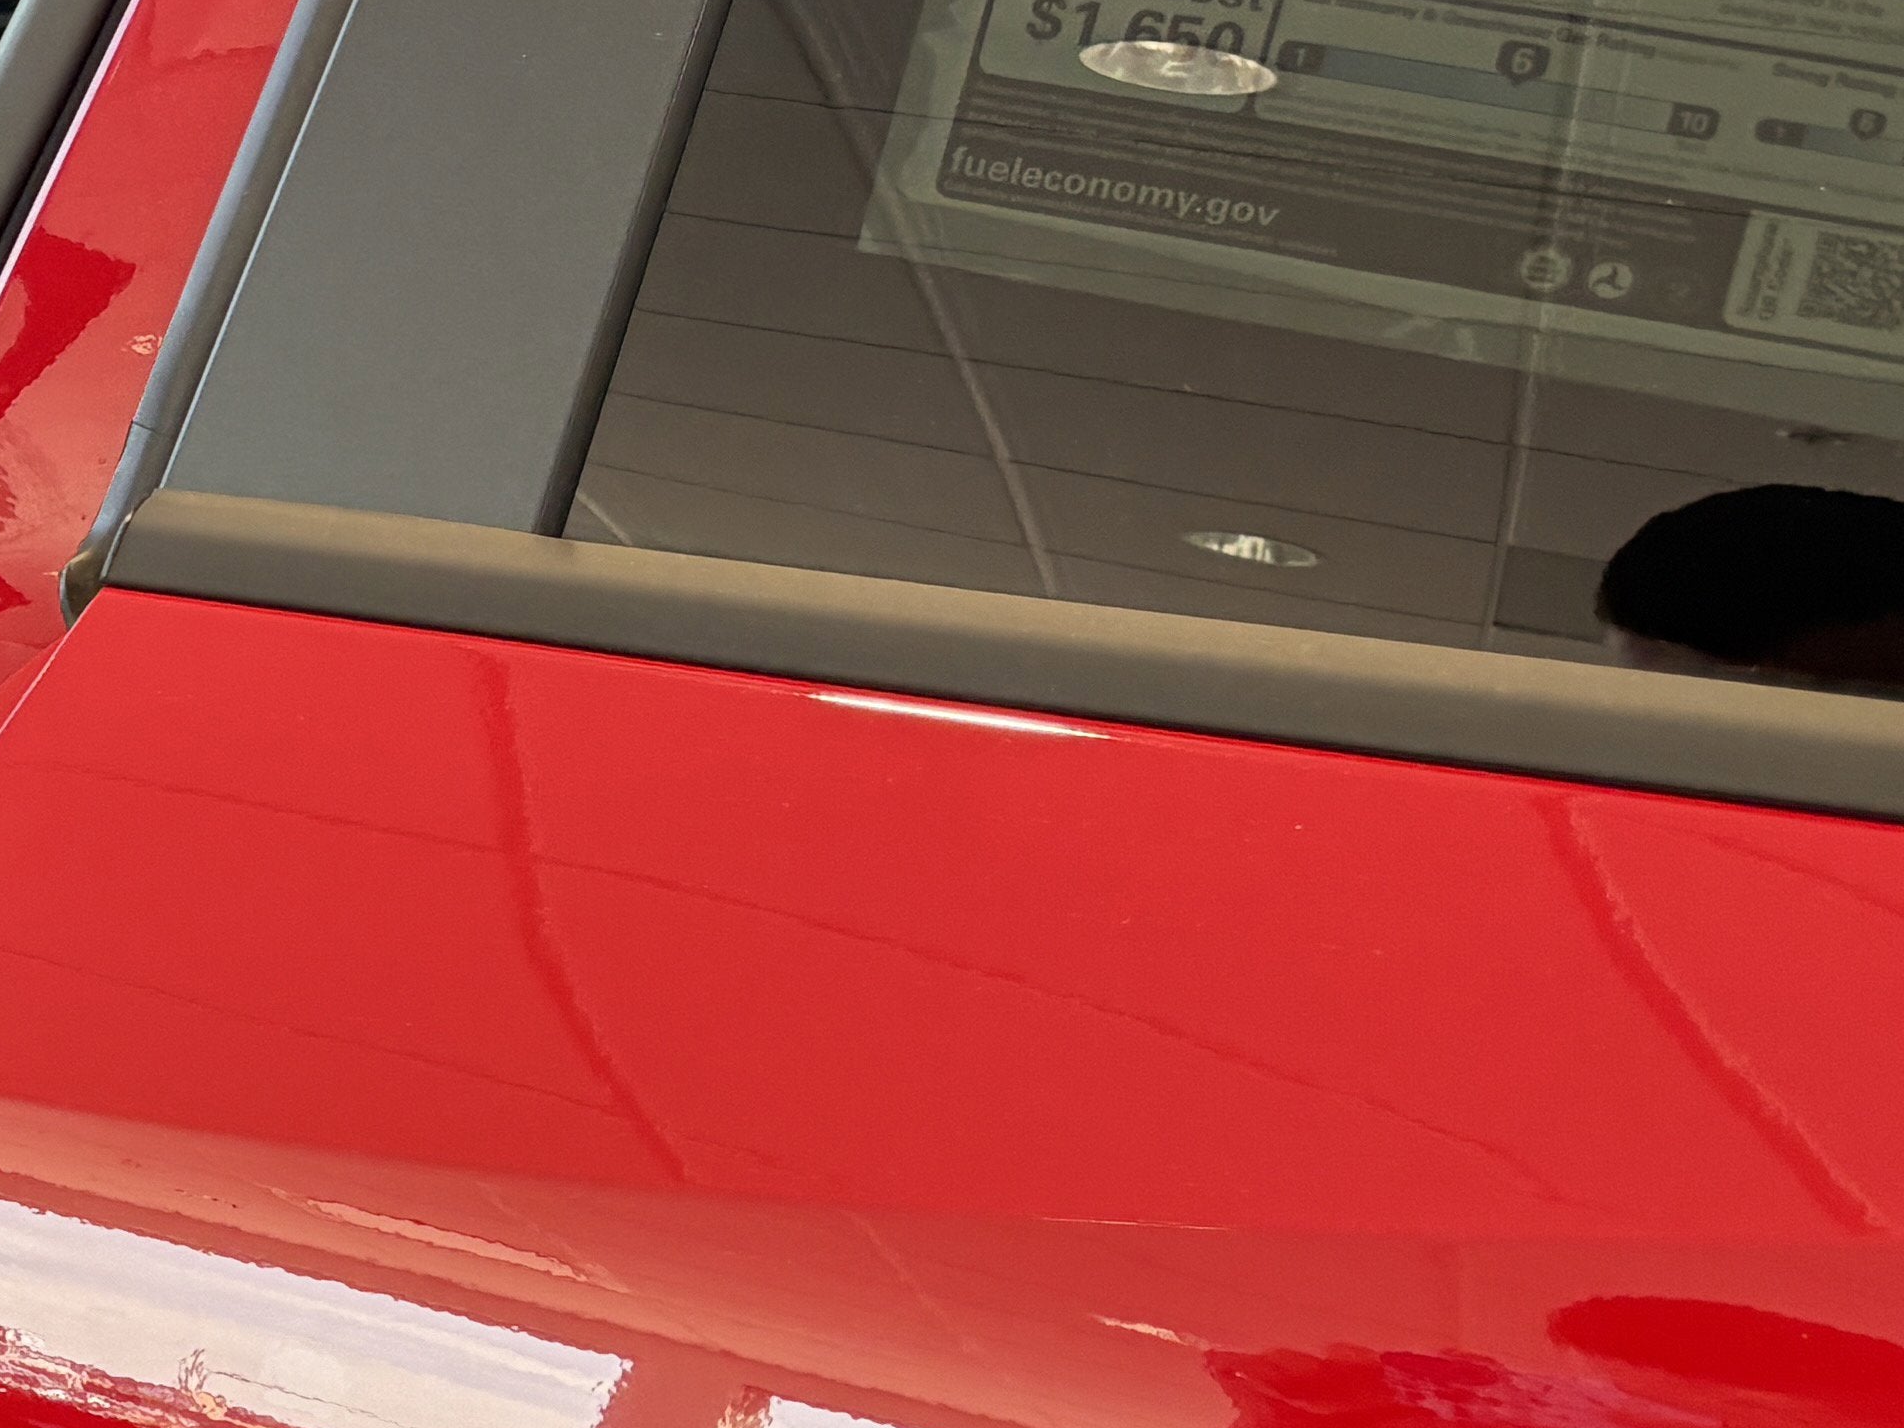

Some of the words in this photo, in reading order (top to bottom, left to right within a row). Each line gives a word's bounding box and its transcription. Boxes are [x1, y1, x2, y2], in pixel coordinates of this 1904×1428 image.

[1511, 48, 1535, 72] 6
[1679, 111, 1709, 133] 10
[950, 146, 1282, 227] fueleconomy.gov
